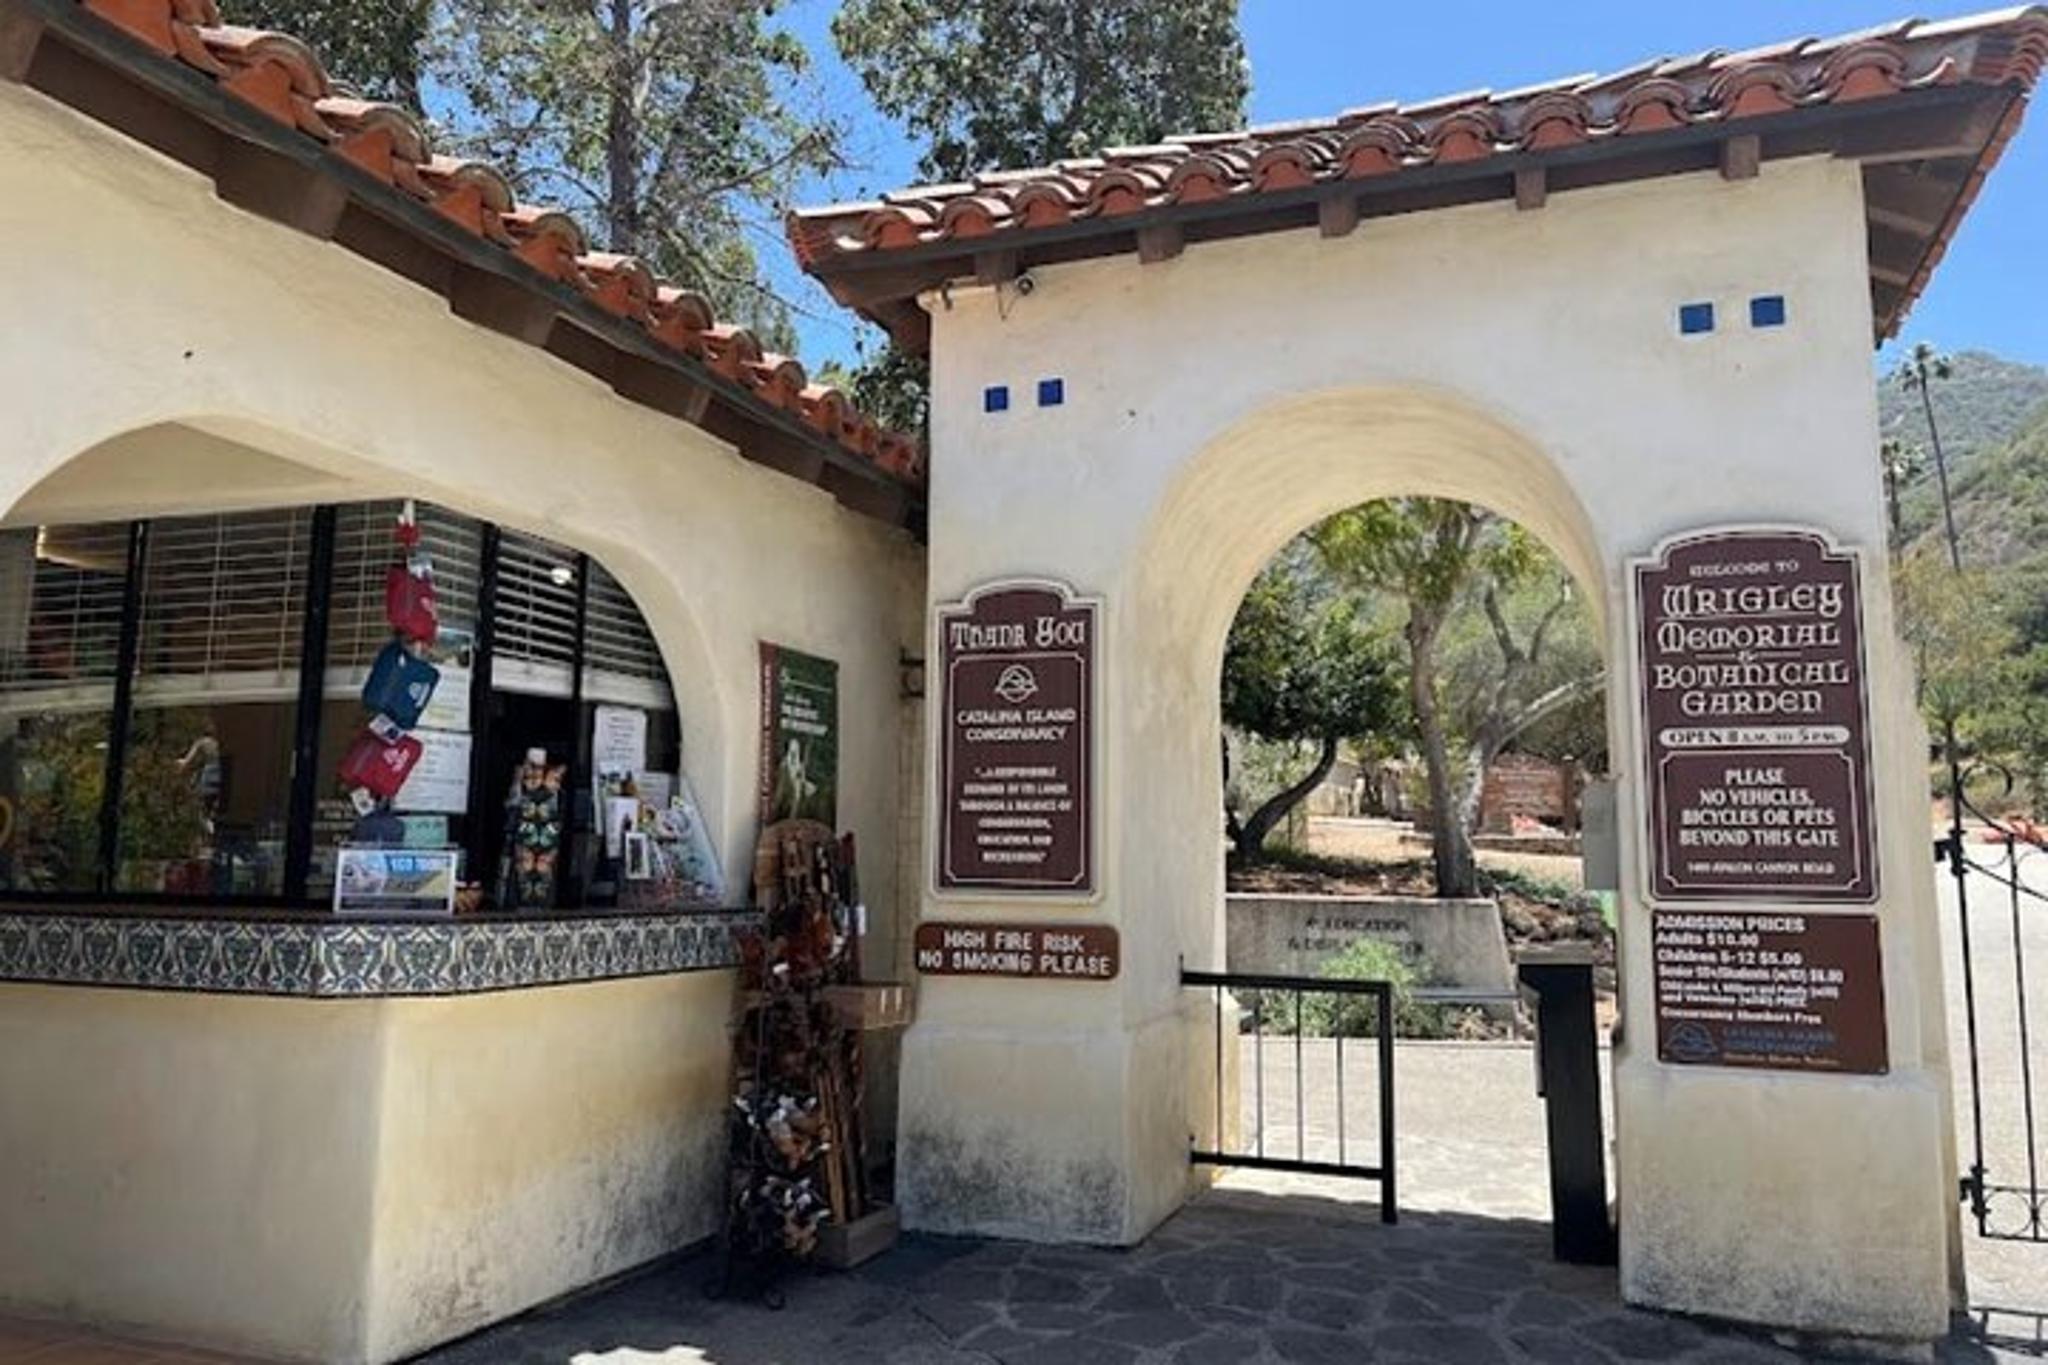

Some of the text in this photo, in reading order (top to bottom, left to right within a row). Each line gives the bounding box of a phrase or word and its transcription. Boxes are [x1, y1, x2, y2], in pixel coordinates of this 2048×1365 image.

[1775, 559, 1800, 573] TO
[1669, 729, 1722, 744] OPEN
[1725, 768, 1785, 785] PLEASE
[1700, 788, 1727, 805] NO
[1681, 808, 1836, 825] BICYCLES OR PETS
[1679, 830, 1839, 846] BEYOND THIS GATE
[1656, 914, 1806, 933] ADMISSION PRICES
[943, 929, 1085, 953] HIGH FIRE RISK
[1656, 931, 1704, 945] Adults
[918, 950, 1112, 976] NO SMOKING PLEASE
[1657, 947, 1718, 963] Children
